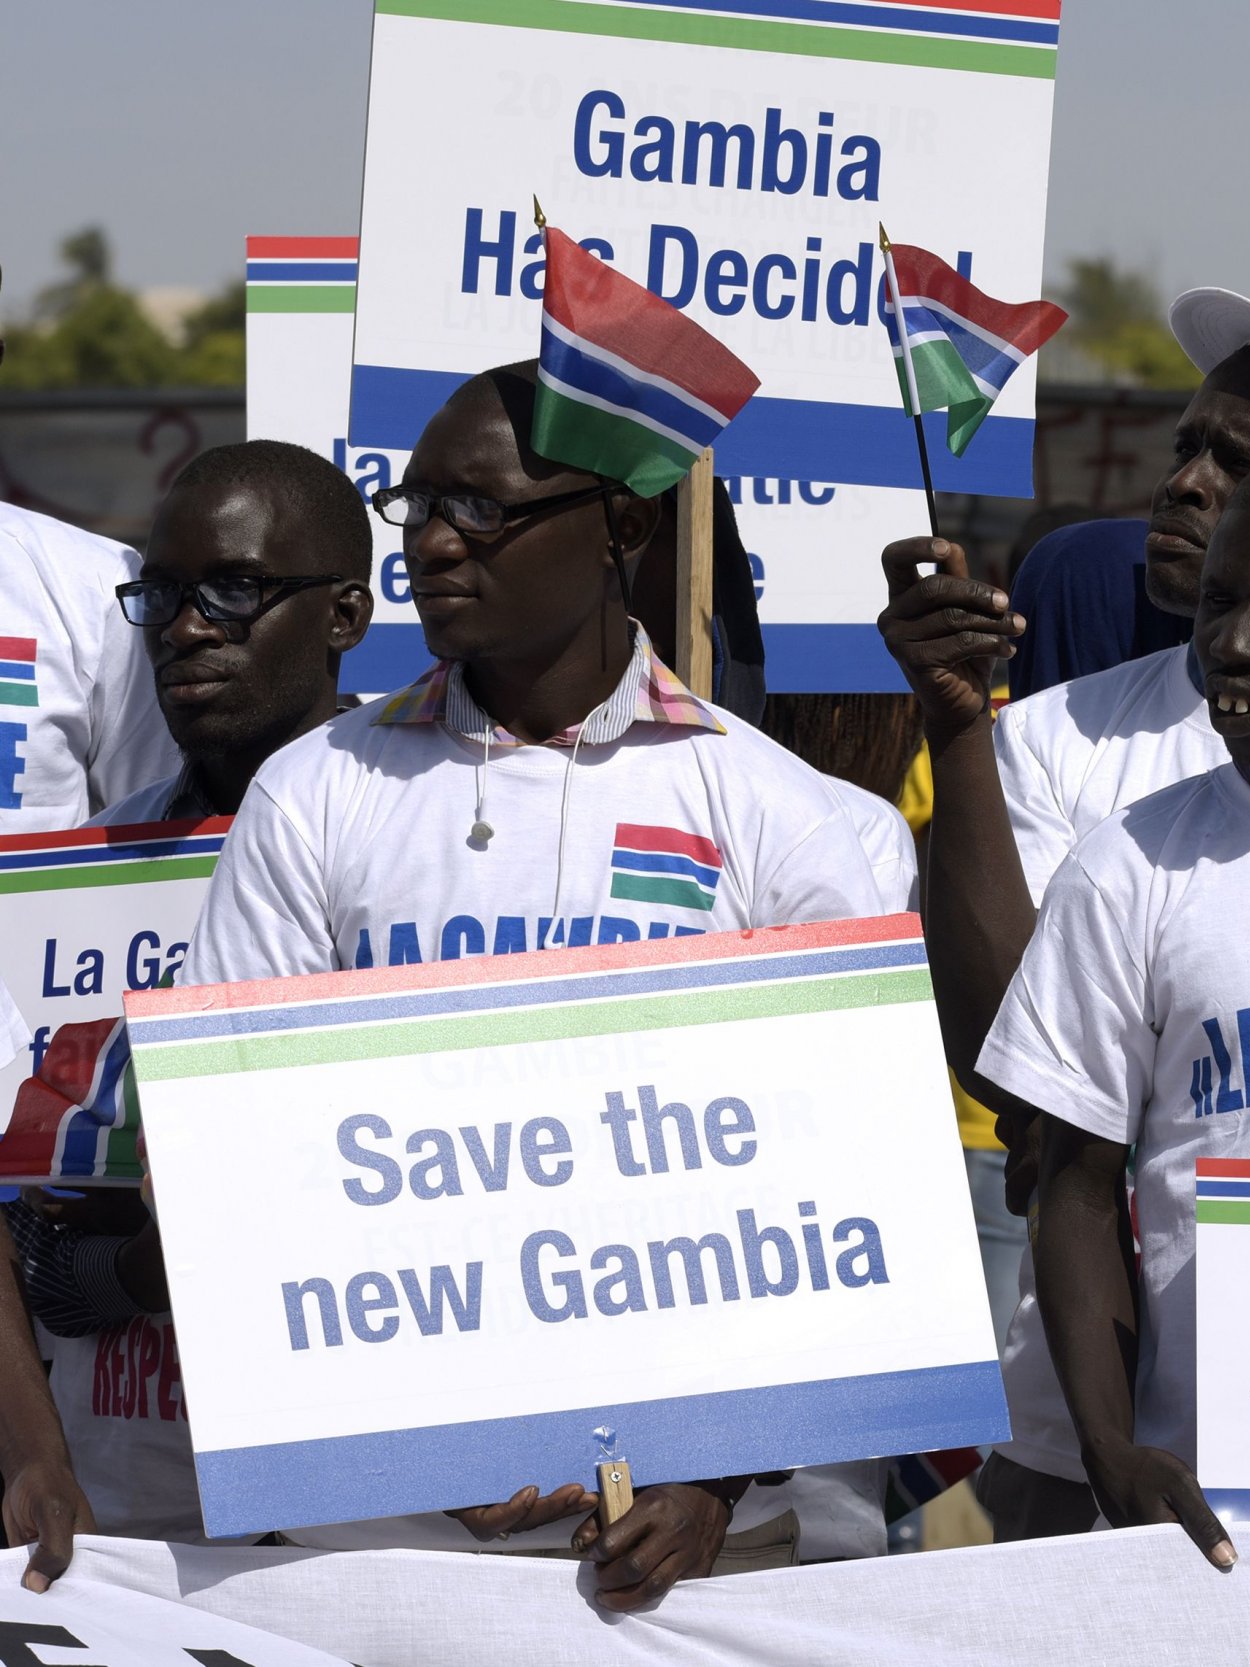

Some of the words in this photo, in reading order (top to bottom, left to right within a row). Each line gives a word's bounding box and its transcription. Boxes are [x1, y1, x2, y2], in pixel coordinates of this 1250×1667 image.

[573, 89, 882, 202] Gambia
[646, 223, 973, 331] Decid
[42, 938, 104, 998] La
[338, 1114, 573, 1207] Save
[601, 1085, 758, 1177] the
[281, 1260, 483, 1352] new
[520, 1201, 891, 1324] Gambia
